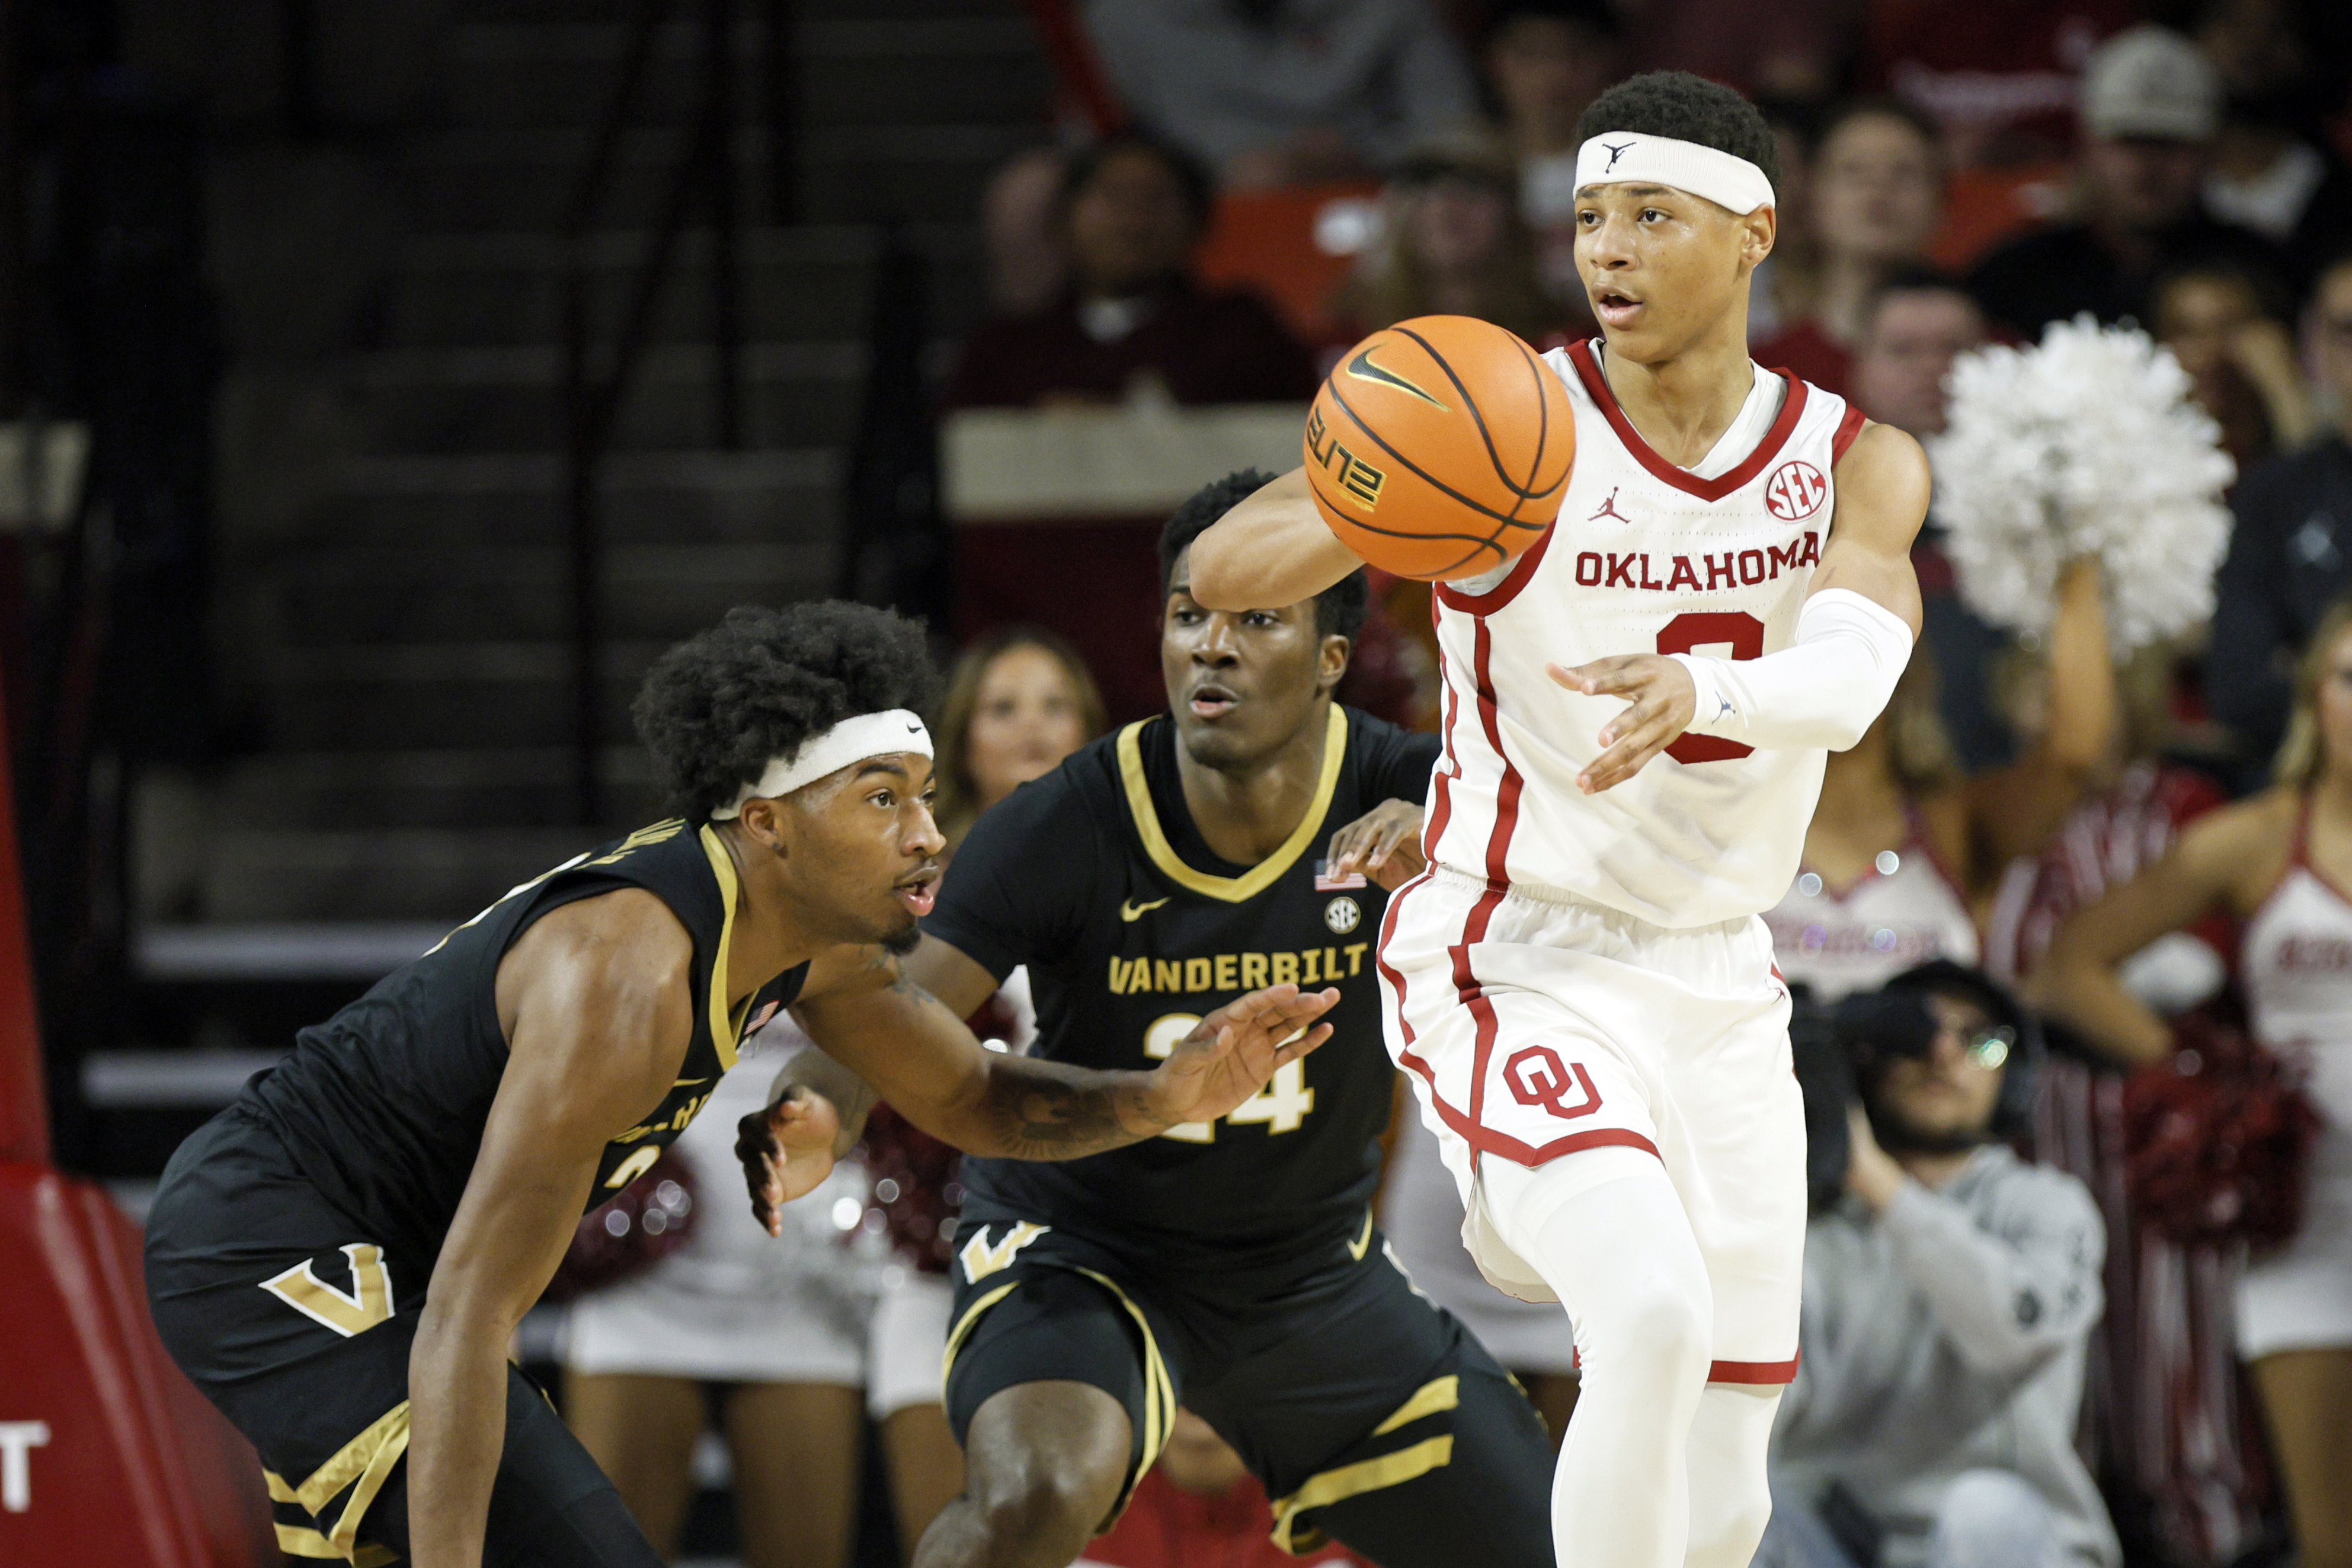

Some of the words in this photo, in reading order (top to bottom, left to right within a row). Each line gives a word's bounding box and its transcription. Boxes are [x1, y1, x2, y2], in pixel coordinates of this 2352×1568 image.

[1307, 404, 1387, 505] ELITE
[1765, 460, 1827, 521] SEC
[1576, 531, 1819, 591] OKLAHOMA
[1326, 897, 1360, 933] SEC
[1108, 942, 1368, 995] VANDERBILT
[1502, 1045, 1604, 1119] OU
[258, 1242, 396, 1338] V
